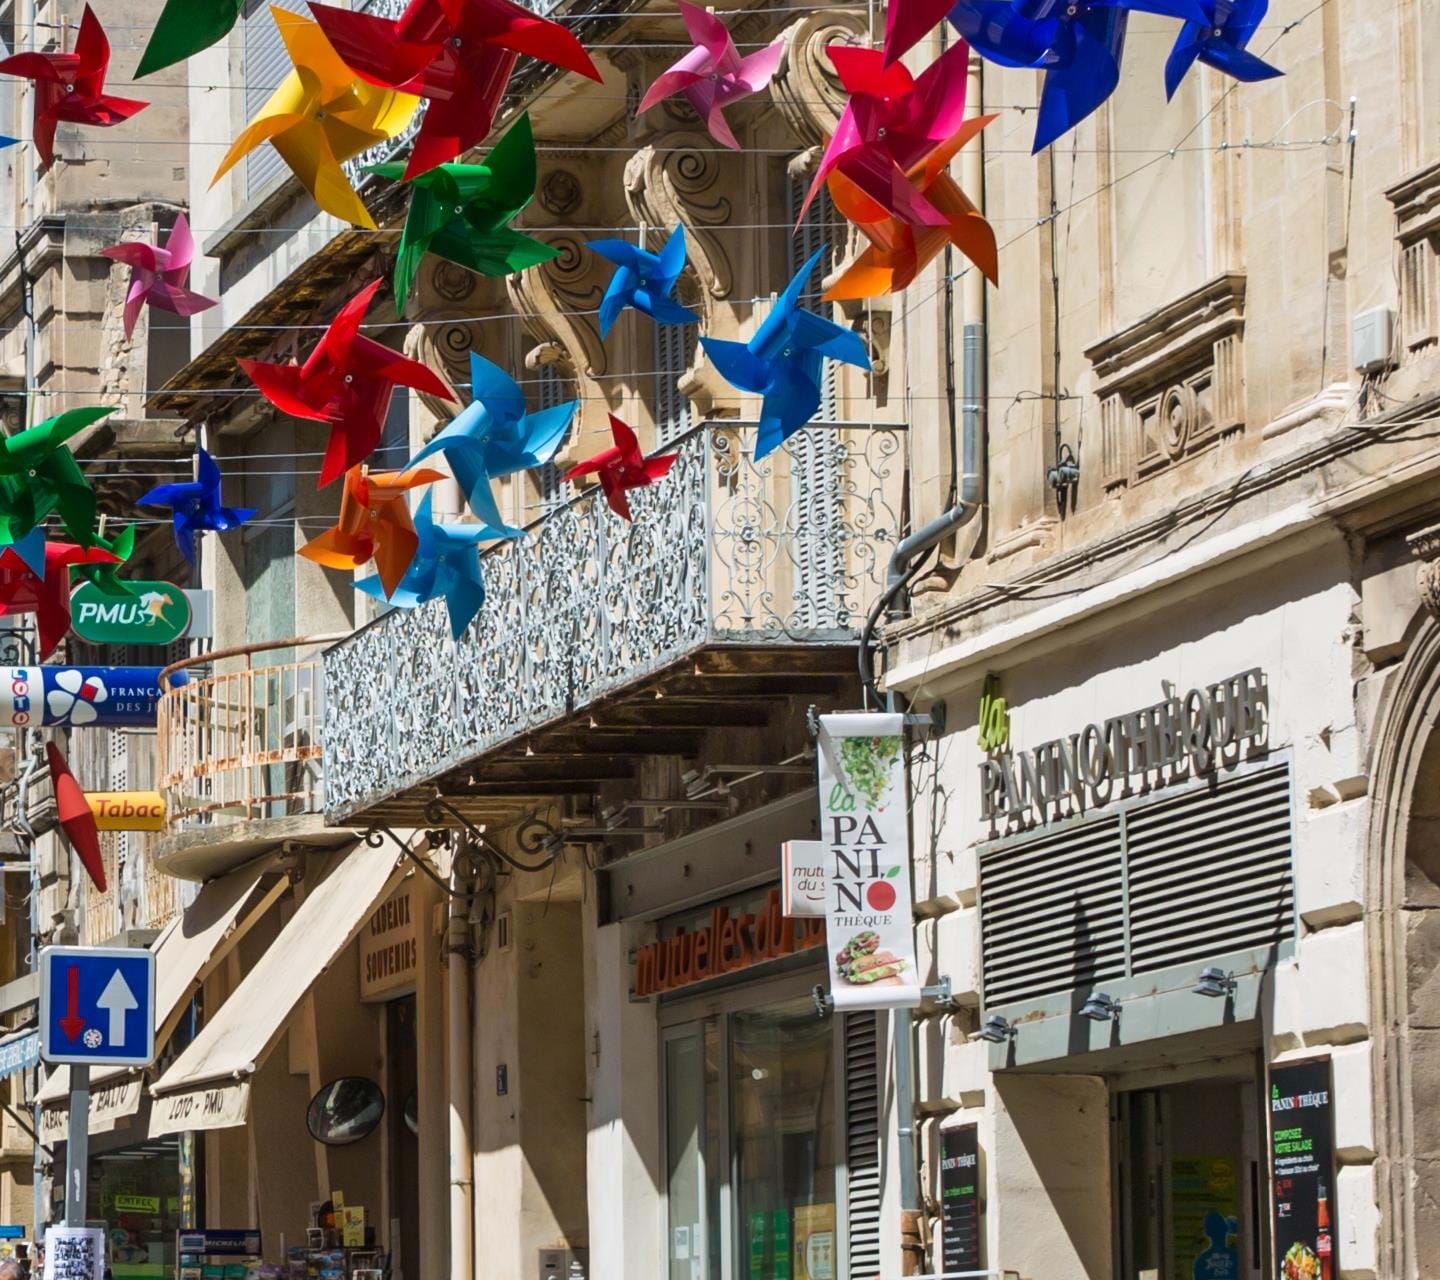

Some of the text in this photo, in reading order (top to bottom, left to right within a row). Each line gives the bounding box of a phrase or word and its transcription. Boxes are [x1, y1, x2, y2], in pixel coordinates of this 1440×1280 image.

[79, 603, 139, 624] PMU
[111, 686, 163, 700] FRANÇA
[116, 702, 141, 712] DES
[977, 667, 1263, 827] PANINOTHÈQUE
[96, 799, 161, 818] Tabac
[827, 782, 857, 812] la
[829, 814, 887, 846] PA
[834, 914, 892, 927] THÈQUE
[636, 907, 754, 996] mutuelles
[757, 889, 795, 959] du
[366, 937, 417, 983] SOUVENIRS
[169, 1095, 191, 1120] LOTO
[203, 1091, 224, 1116] PMU
